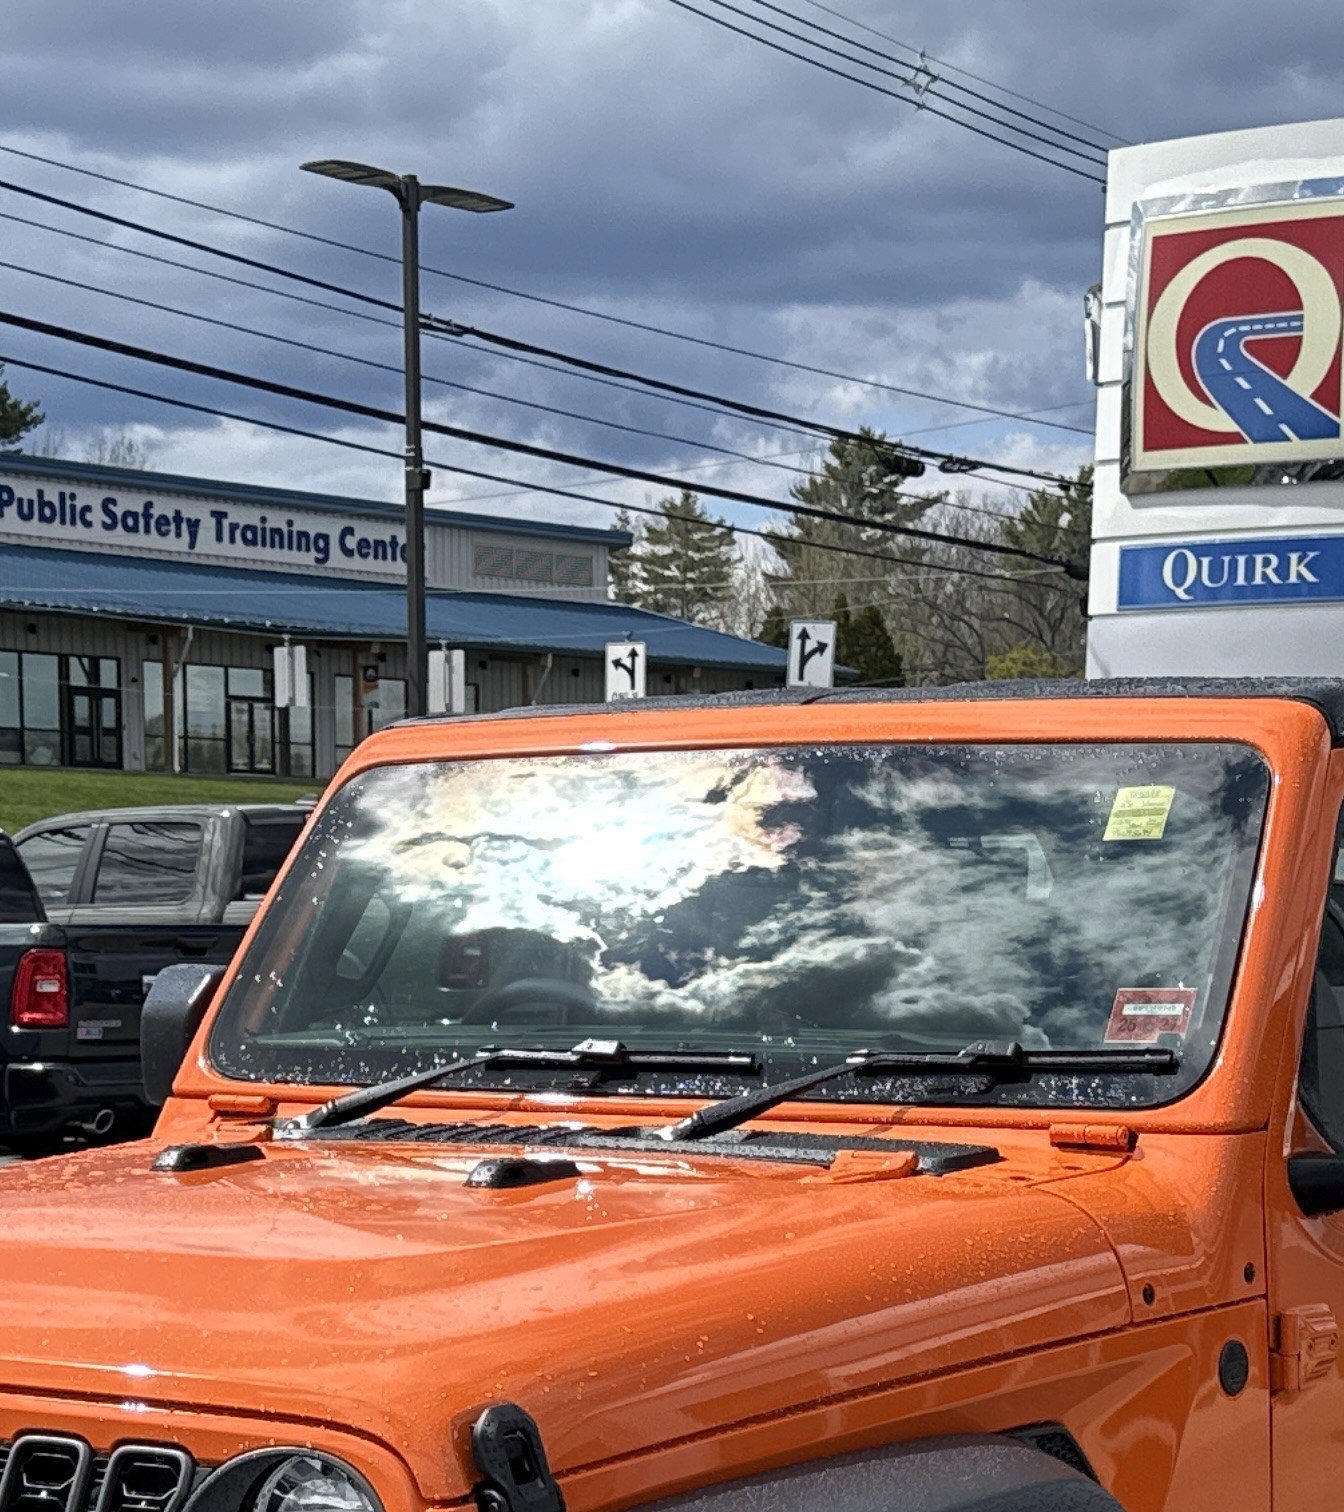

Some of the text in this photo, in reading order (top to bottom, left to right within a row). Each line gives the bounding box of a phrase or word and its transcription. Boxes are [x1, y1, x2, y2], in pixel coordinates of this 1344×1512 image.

[101, 497, 201, 549] Safety
[210, 511, 331, 565] Training
[339, 526, 408, 564] Cent
[1162, 548, 1321, 600] QUIRK
